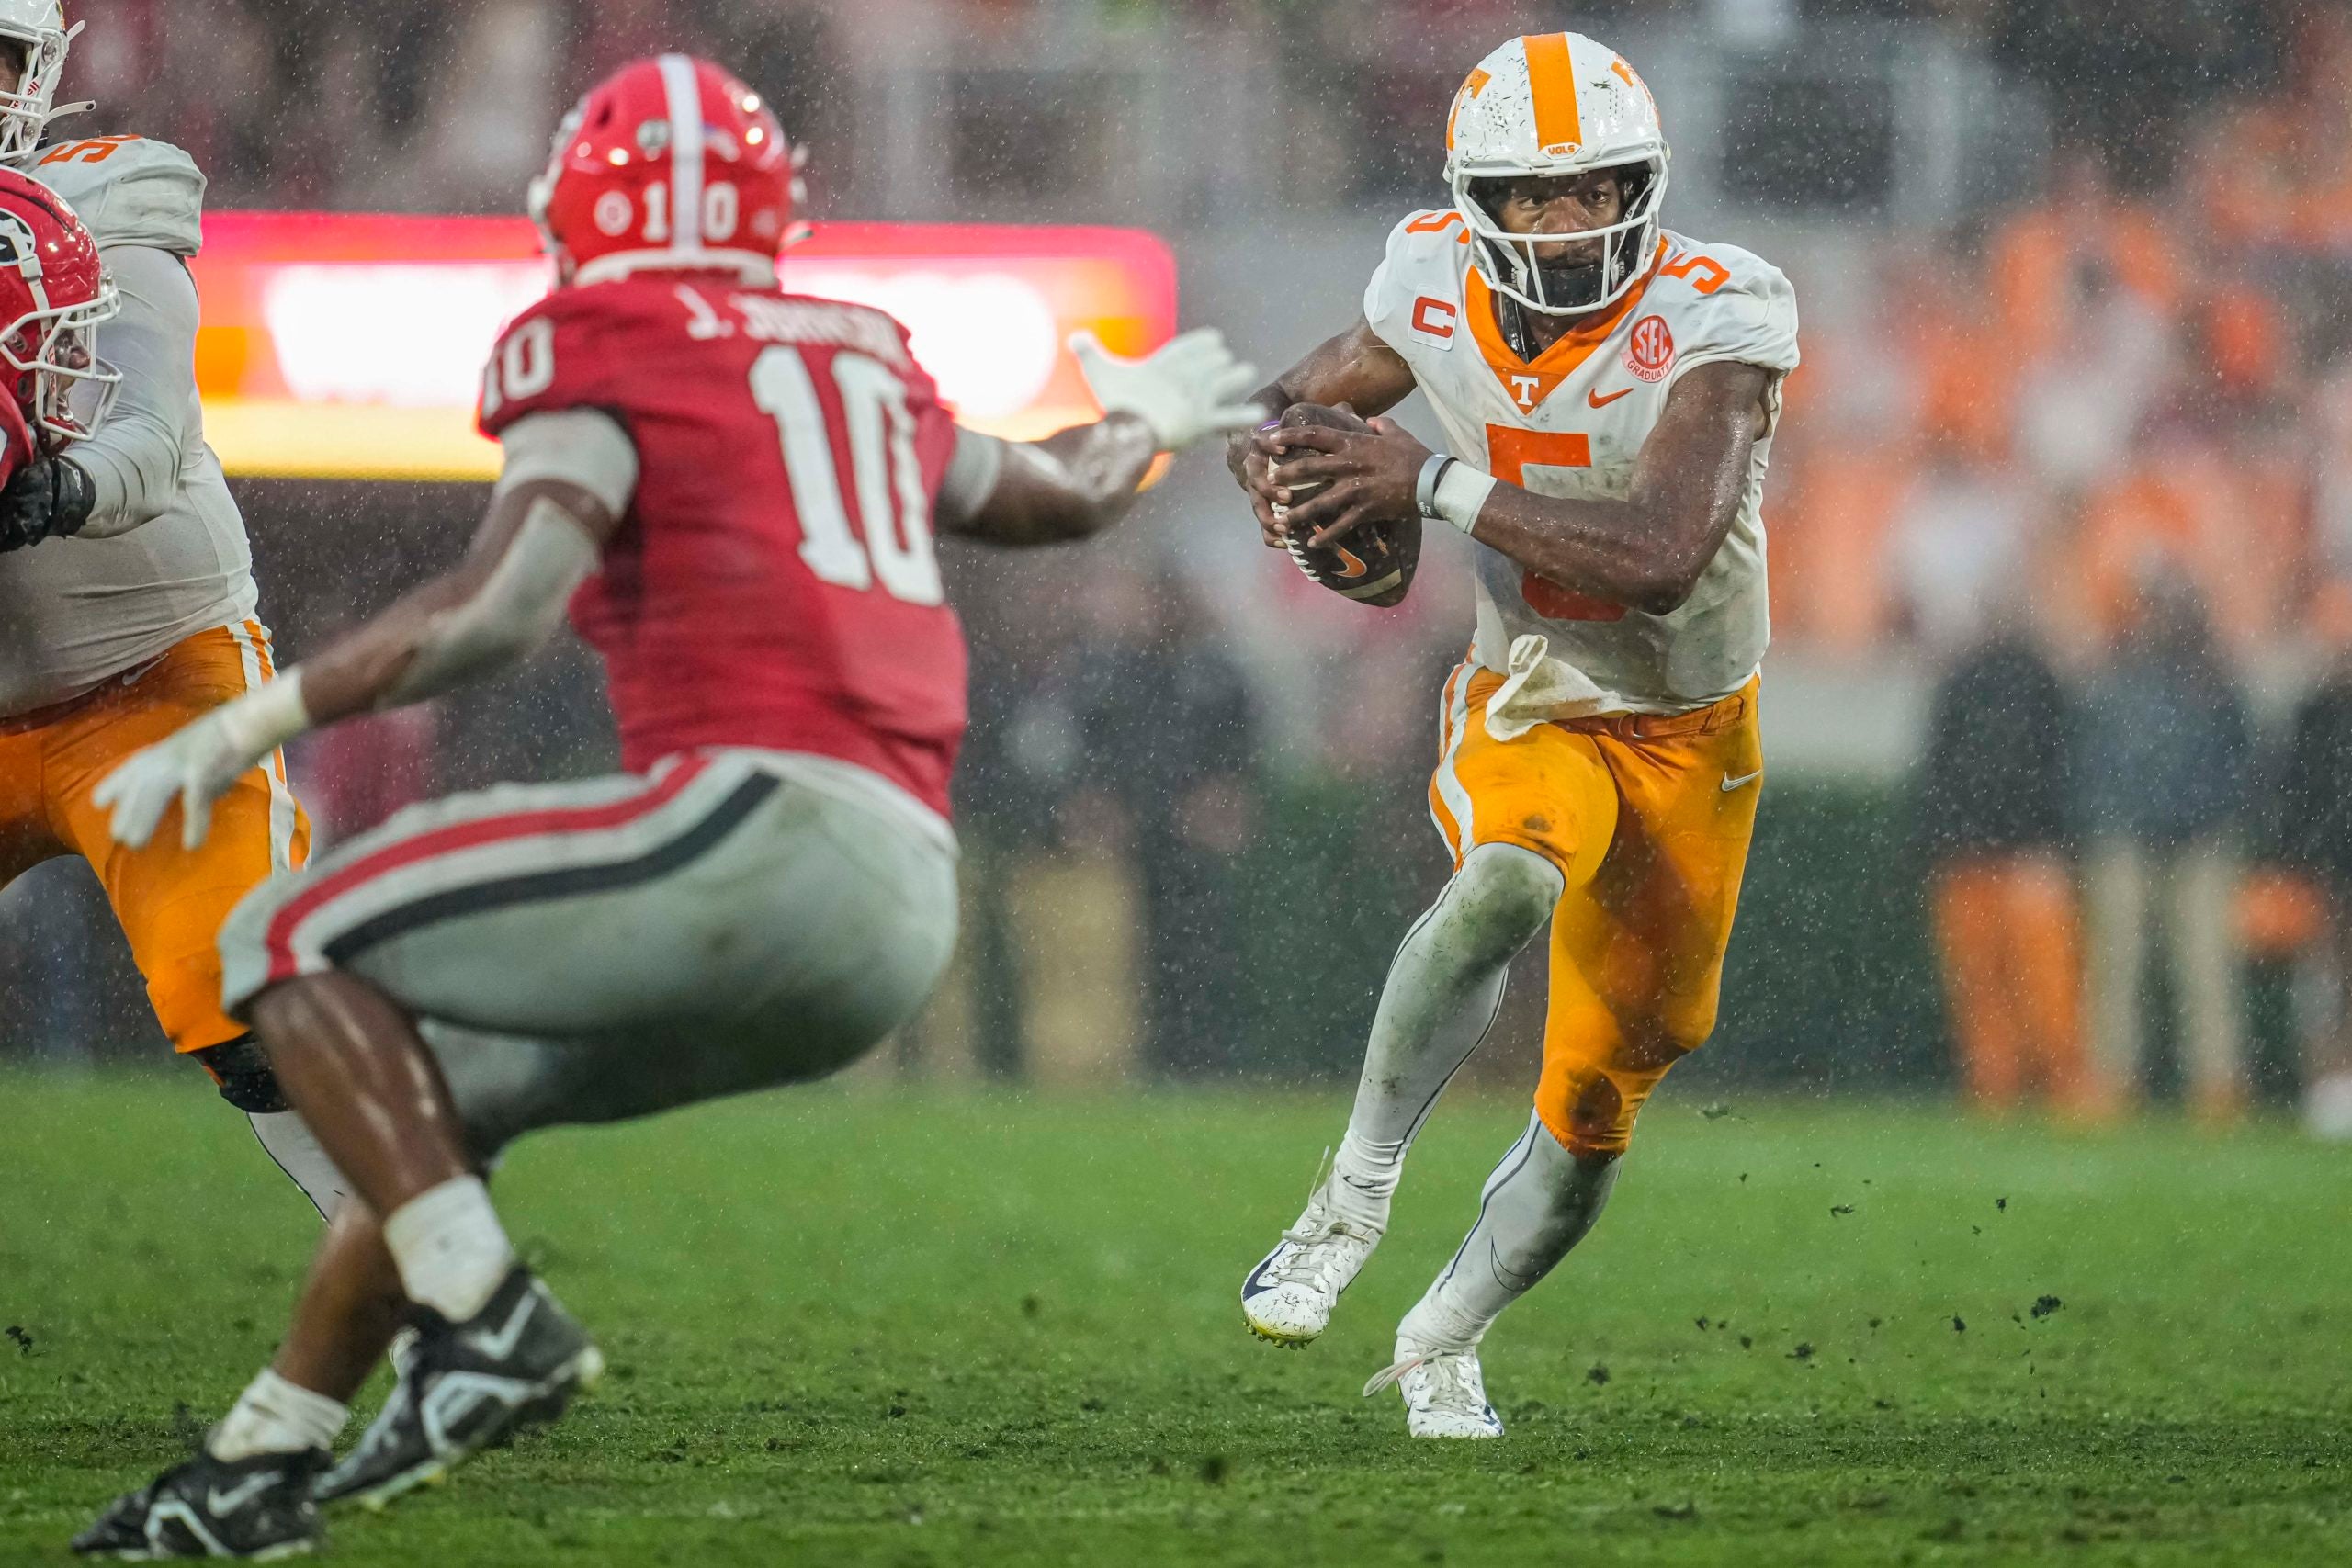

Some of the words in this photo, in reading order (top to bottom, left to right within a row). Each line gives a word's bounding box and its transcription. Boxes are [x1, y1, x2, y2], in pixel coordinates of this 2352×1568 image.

[1548, 145, 1576, 155] VOLS
[643, 182, 738, 242] 10
[1404, 212, 1470, 244] 5
[1659, 251, 1731, 295] 5
[1412, 296, 1457, 338] C
[1635, 320, 1669, 364] SEC
[1511, 375, 1539, 406] T
[1627, 360, 1670, 380] GRADUATE
[747, 344, 944, 605] 10
